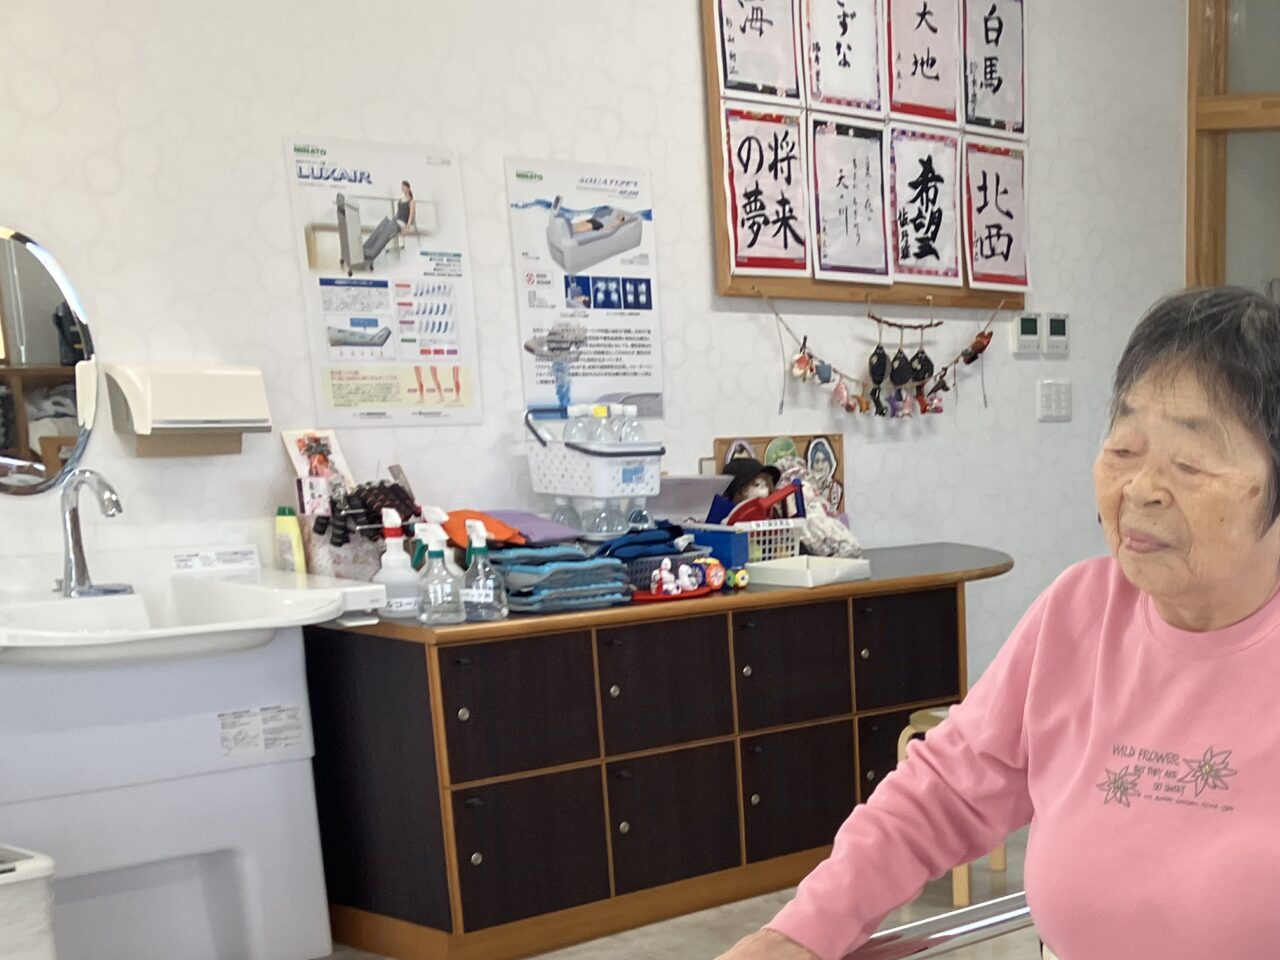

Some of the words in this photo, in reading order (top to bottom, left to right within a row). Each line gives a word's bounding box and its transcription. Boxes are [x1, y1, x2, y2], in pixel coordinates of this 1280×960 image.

[914, 1, 940, 81] 大地
[980, 4, 1004, 94] 白馬
[737, 136, 770, 248] の夢
[768, 130, 805, 250] 将来
[907, 154, 944, 260] 希望
[976, 169, 1013, 262] 北西
[1112, 743, 1135, 758] WILD
